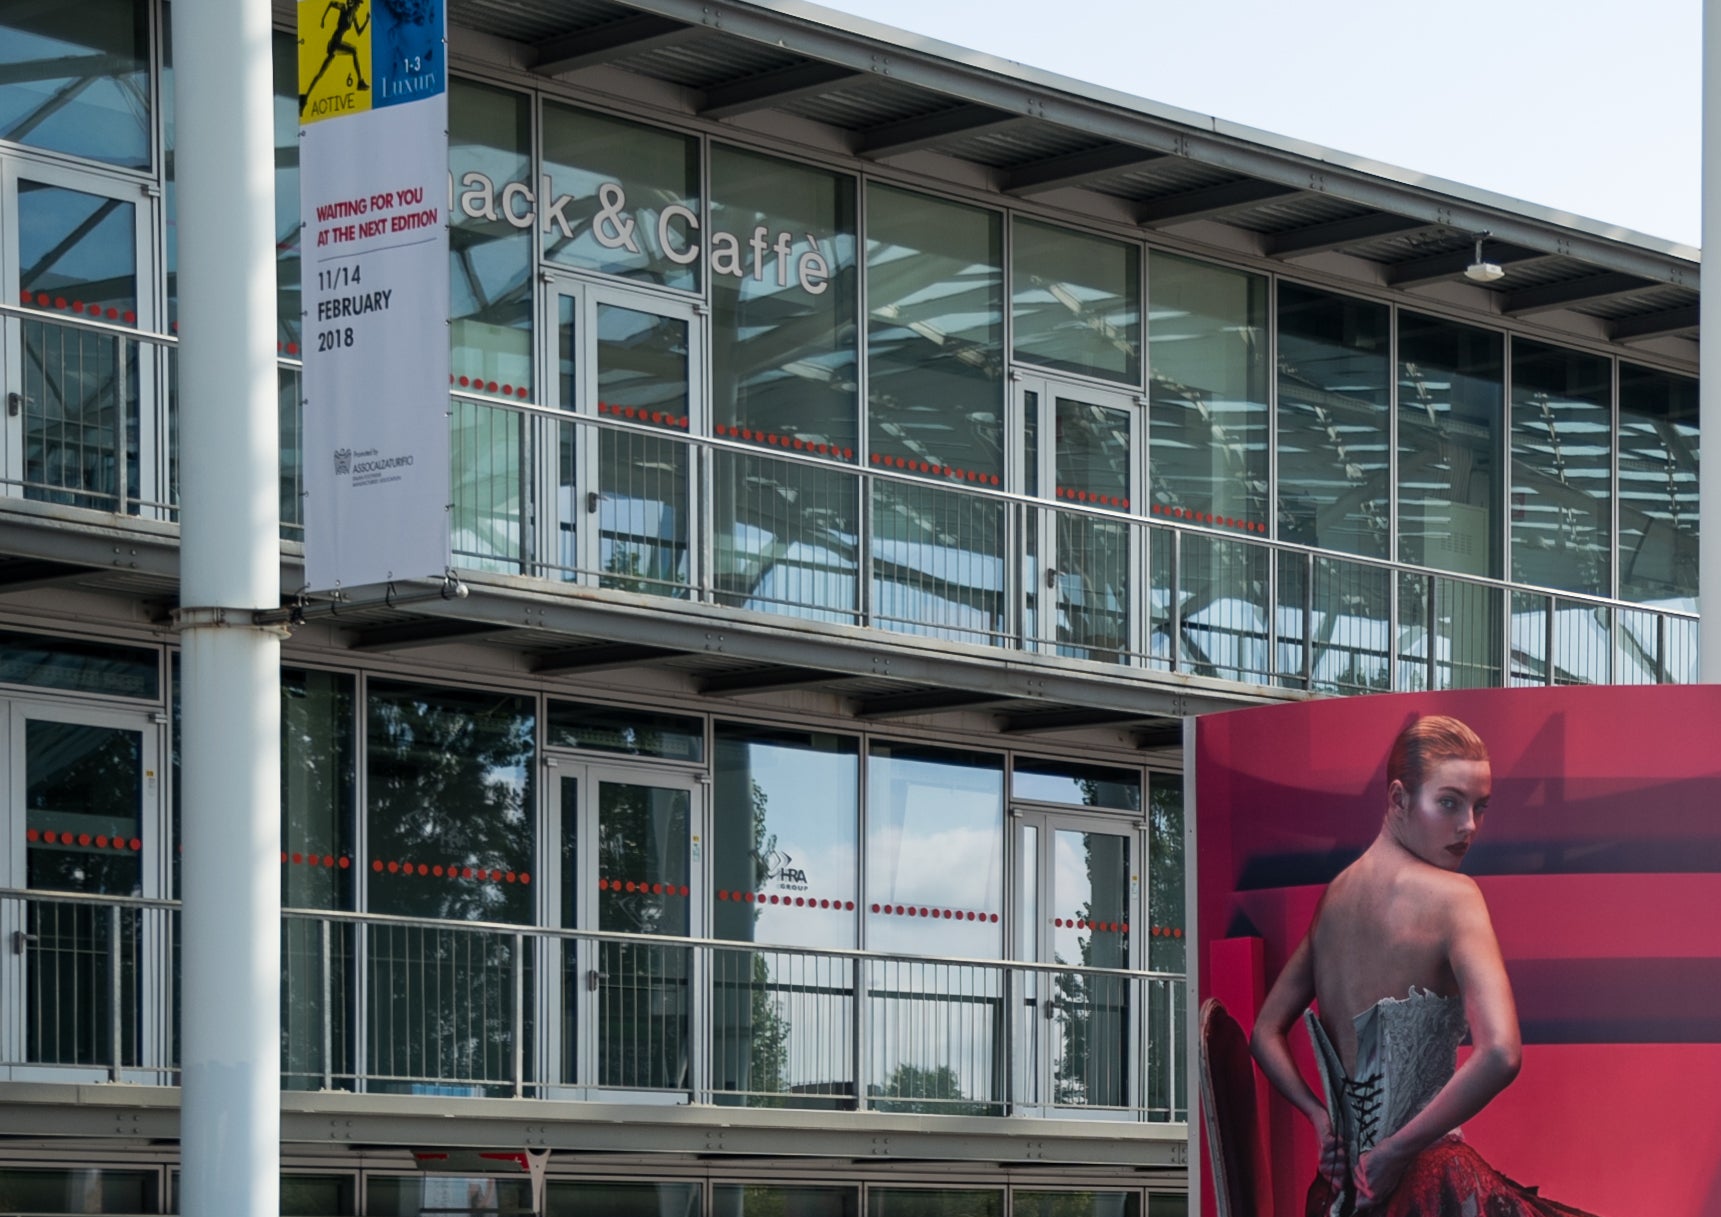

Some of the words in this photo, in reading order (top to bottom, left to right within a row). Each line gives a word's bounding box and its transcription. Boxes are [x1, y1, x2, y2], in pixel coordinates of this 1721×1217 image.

[404, 56, 421, 73] 1-3
[346, 73, 354, 87] 6
[382, 73, 436, 98] Luxury
[316, 198, 367, 223] WAITING
[370, 193, 394, 212] FOR
[396, 187, 423, 206] YOU
[317, 229, 329, 247] AT
[332, 225, 356, 243] THE
[359, 218, 388, 239] NEXT
[391, 208, 438, 232] EDITION
[449, 169, 575, 239] ack
[593, 182, 640, 254] &
[657, 204, 830, 295] Caffè
[318, 264, 361, 291] 11/14
[317, 289, 393, 322] FEBRUARY
[318, 327, 354, 352] 2018
[780, 883, 808, 891] GROUP
[781, 867, 808, 884] HRA
